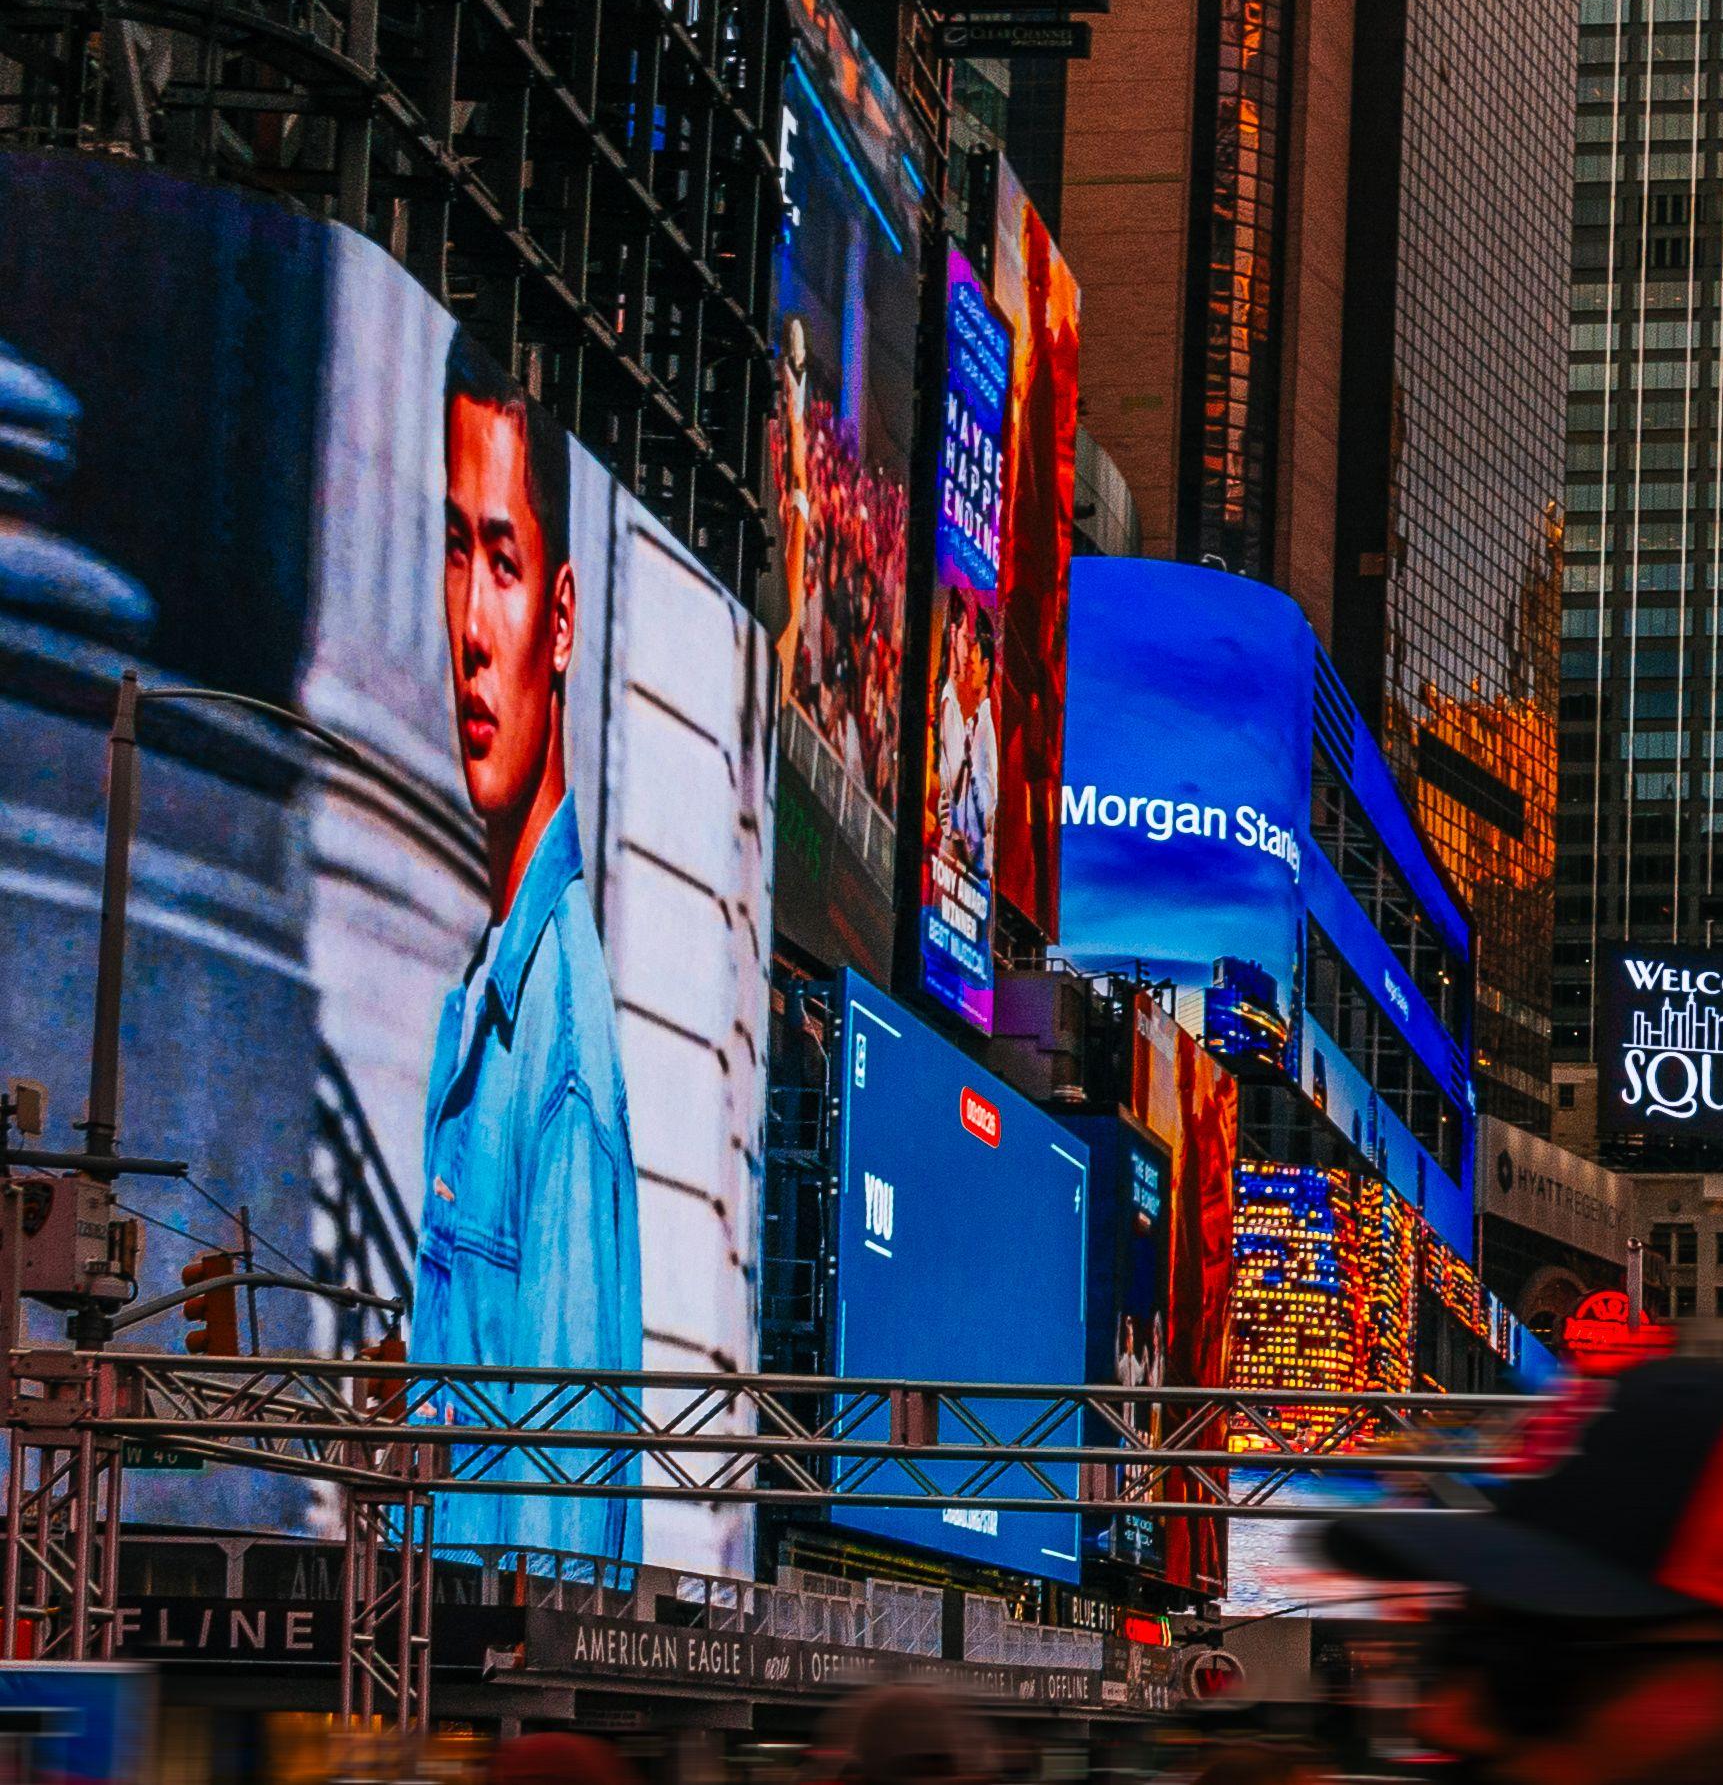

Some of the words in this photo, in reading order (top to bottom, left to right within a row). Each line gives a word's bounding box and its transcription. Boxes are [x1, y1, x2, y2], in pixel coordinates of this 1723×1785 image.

[1061, 786, 1227, 840] Morgan
[1236, 805, 1301, 885] Stanley
[865, 1171, 894, 1241] YOU
[1517, 1166, 1563, 1206] HYATT
[127, 1446, 142, 1463] W
[1073, 1596, 1096, 1628] BLUE
[574, 1625, 678, 1670] AMERICAN
[688, 1638, 741, 1676] EAGLE
[1047, 1674, 1089, 1700] OFFLINE
